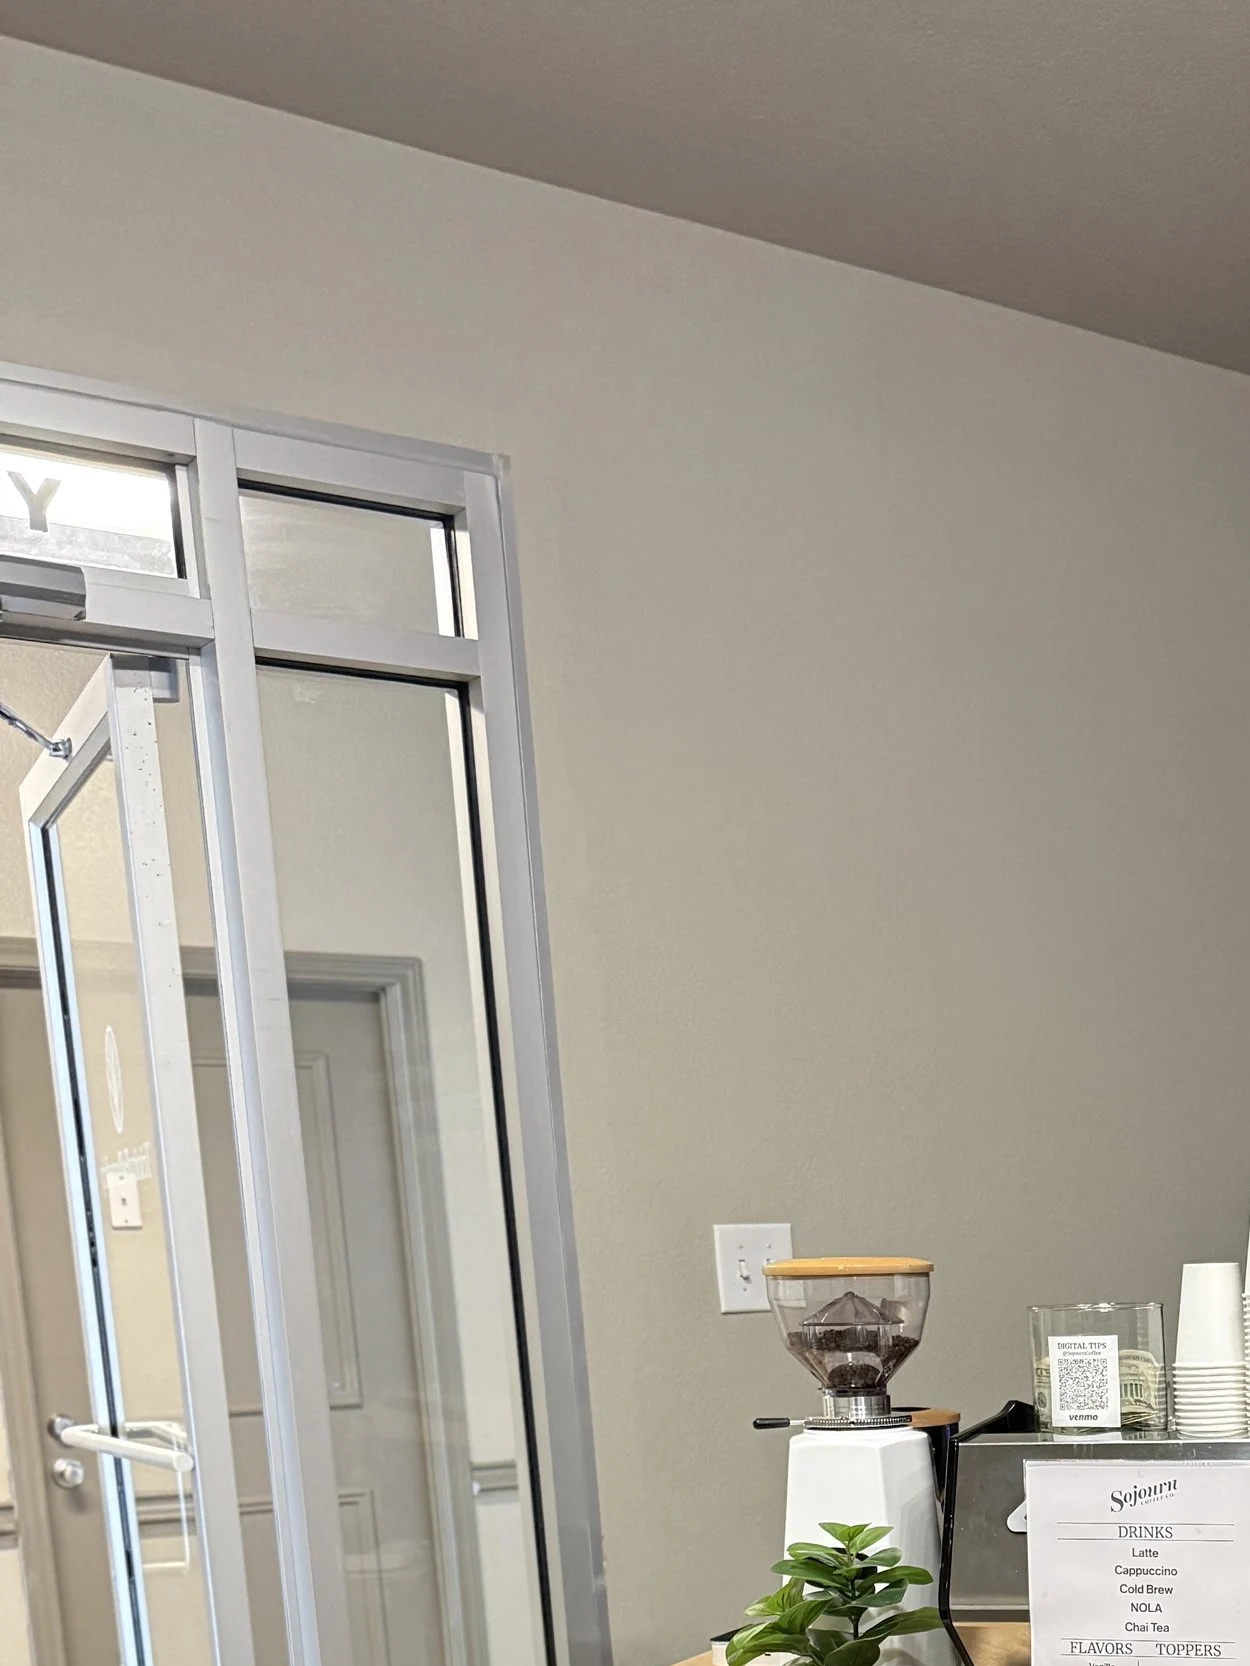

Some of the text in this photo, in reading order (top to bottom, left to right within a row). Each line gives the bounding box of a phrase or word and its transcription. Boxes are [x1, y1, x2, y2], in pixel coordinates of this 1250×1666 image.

[1057, 1342, 1107, 1350] DIGITAL TIPS
[1110, 1479, 1177, 1513] Sojourn
[1118, 1526, 1173, 1539] DRINKS
[1131, 1547, 1159, 1558] Latte
[1114, 1565, 1178, 1578] Cappuccino
[1119, 1583, 1174, 1595] Cold Brew
[1130, 1602, 1163, 1613] NOLA
[1124, 1621, 1170, 1633] Chai Tea
[1070, 1641, 1133, 1655] FLAVORS
[1155, 1643, 1222, 1657] TOPPERS
